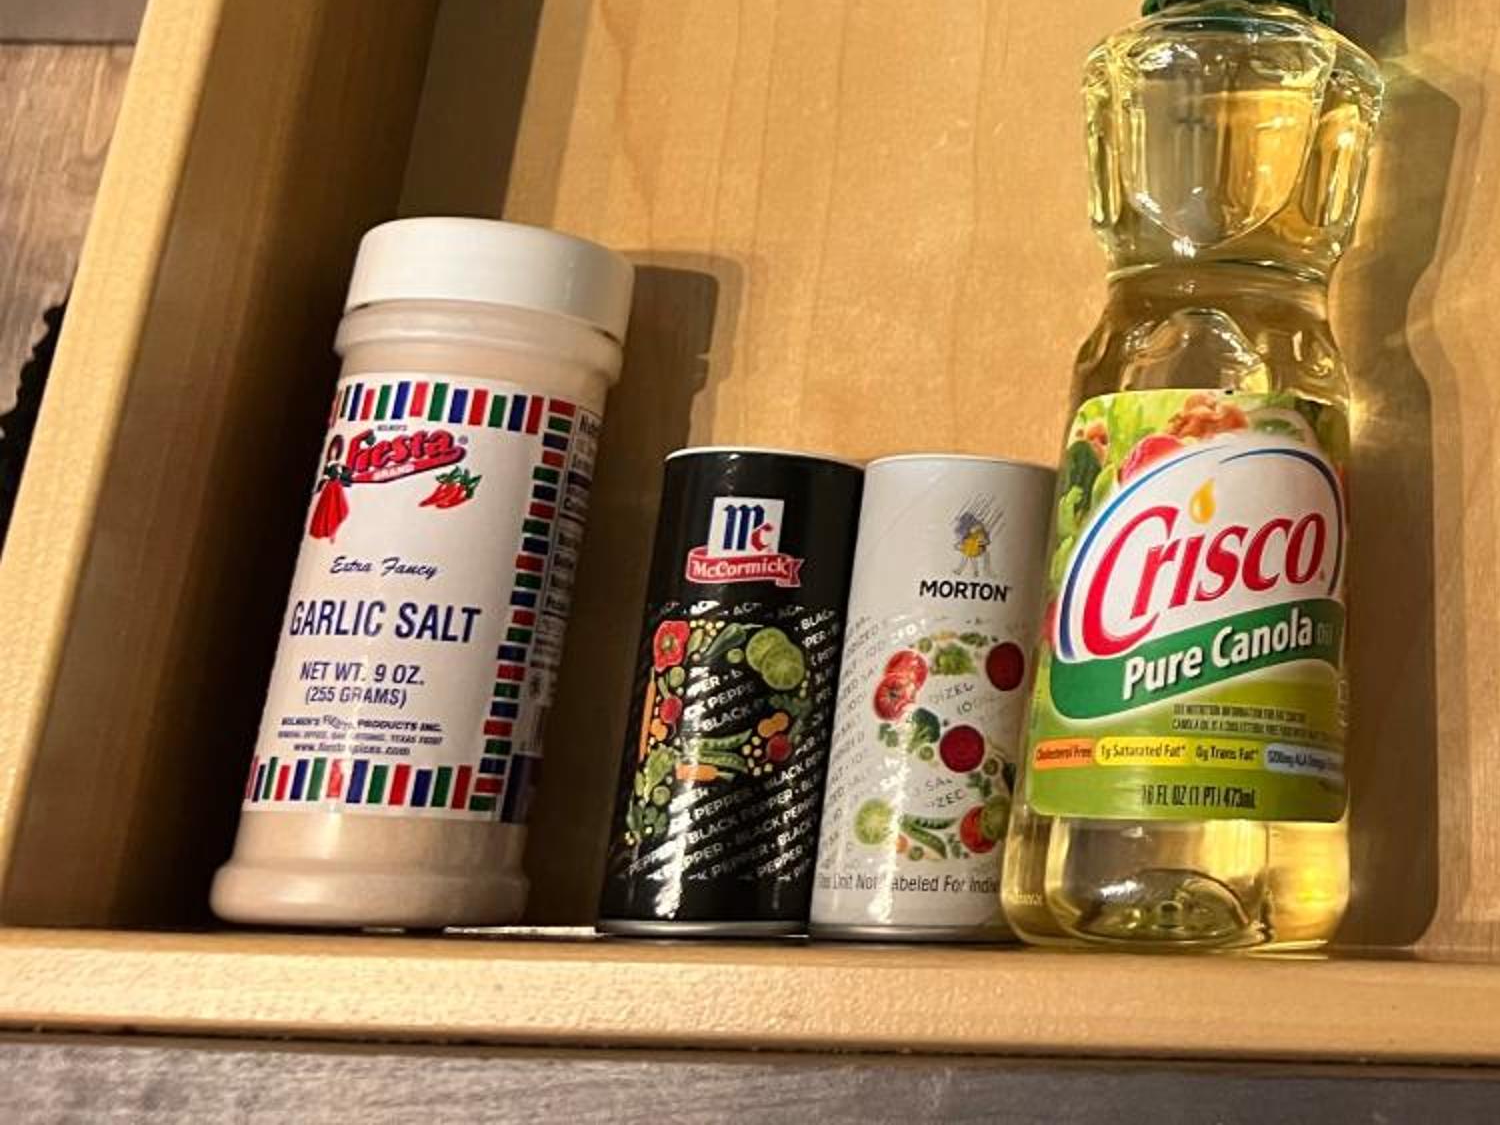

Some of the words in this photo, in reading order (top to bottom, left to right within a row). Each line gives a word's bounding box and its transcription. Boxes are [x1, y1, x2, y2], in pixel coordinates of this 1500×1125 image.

[346, 429, 456, 475] Fiesta
[330, 556, 373, 574] Extra
[380, 557, 438, 580] Fancy
[691, 557, 790, 578] McCormick
[920, 580, 1008, 603] MORTON
[1081, 505, 1326, 658] Crisco
[289, 600, 386, 637] GARLIC
[395, 602, 482, 643] SALT
[1122, 645, 1204, 701] Pure
[1211, 606, 1314, 669] Canola
[300, 662, 330, 682] NET
[335, 663, 366, 682] WT.
[373, 664, 387, 683] 9
[392, 665, 425, 686] OZ.
[305, 686, 335, 706] (255
[339, 687, 408, 709] GRAMS)
[357, 719, 419, 730] PRODUCTS
[1113, 743, 1164, 757] Saturated
[1210, 745, 1237, 760] Trans
[1157, 784, 1168, 806] FL
[1172, 784, 1187, 806] OZ
[886, 875, 940, 892] abeled
[943, 876, 968, 893] For
